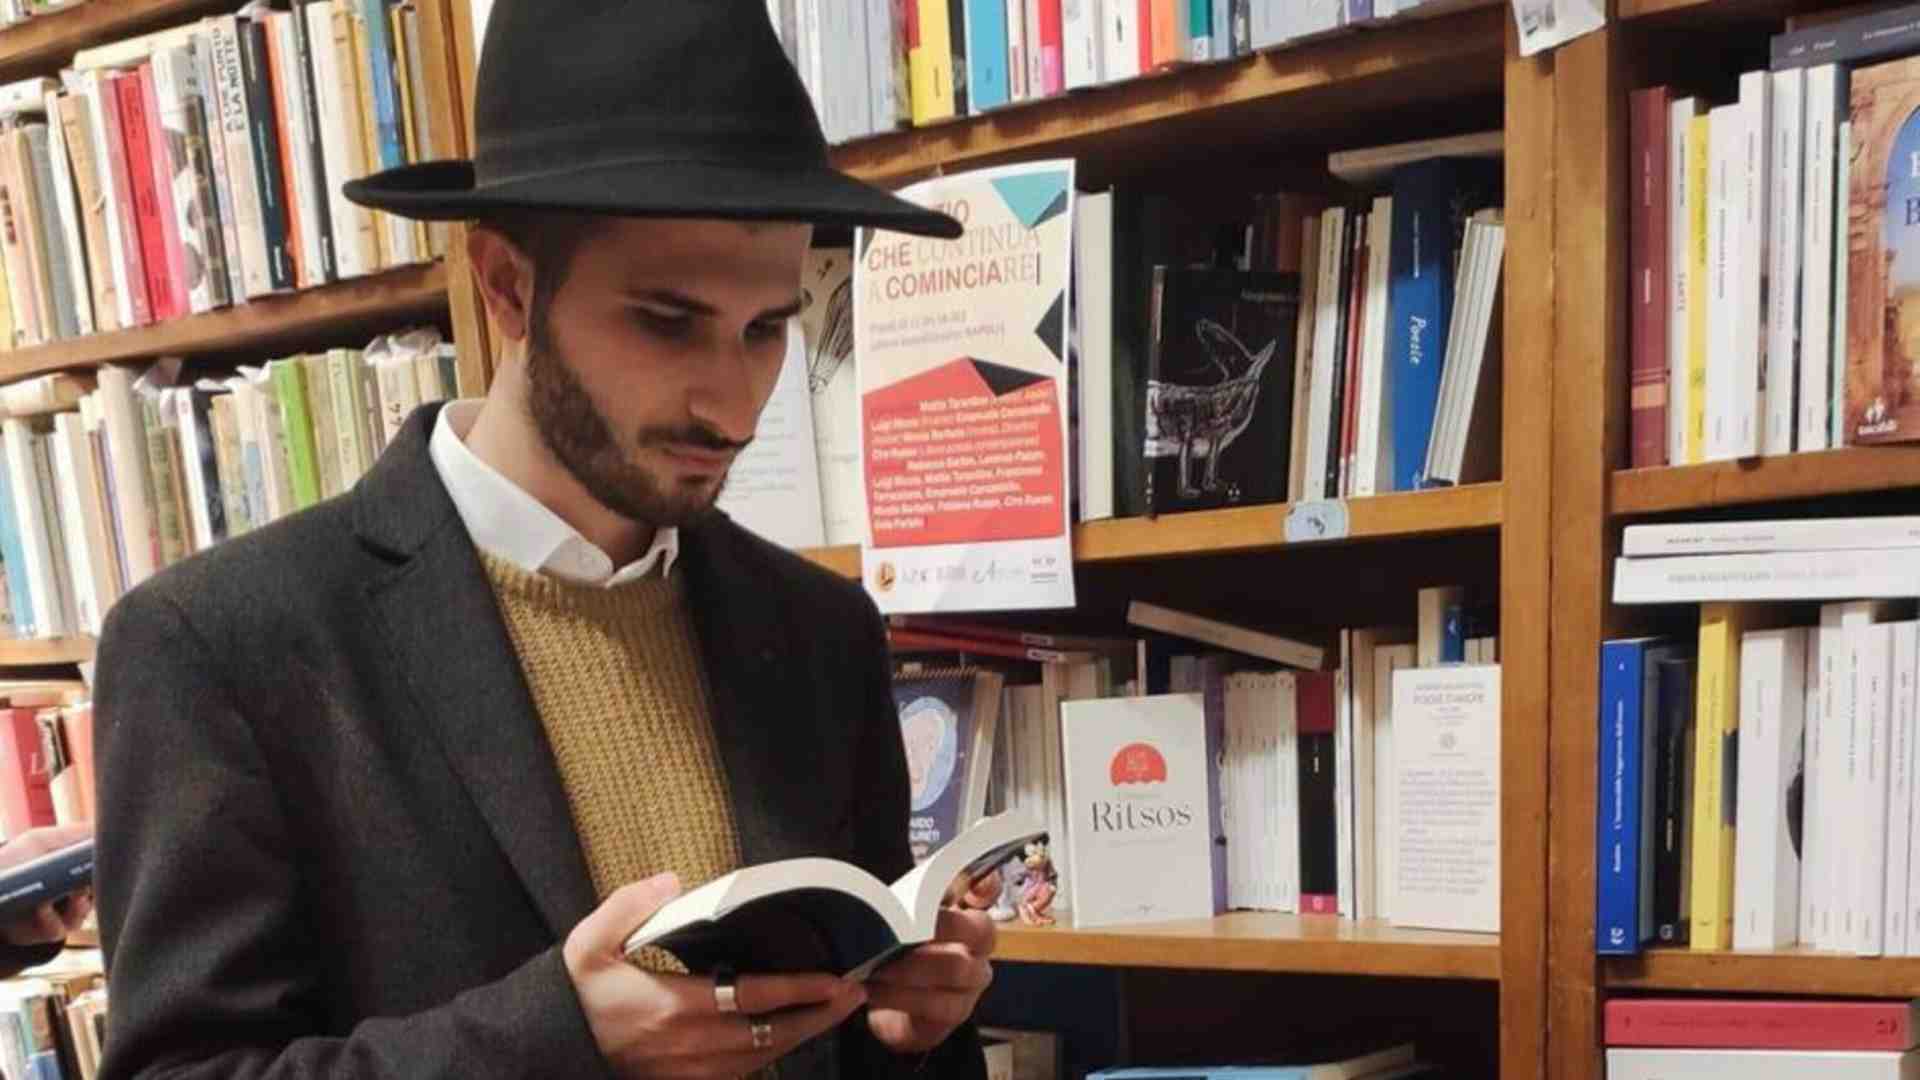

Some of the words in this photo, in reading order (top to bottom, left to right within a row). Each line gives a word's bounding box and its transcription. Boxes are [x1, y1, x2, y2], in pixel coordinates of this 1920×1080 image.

[867, 242, 912, 272] CHE
[1408, 314, 1427, 366] Poesie
[1090, 801, 1194, 833] Ritsos
